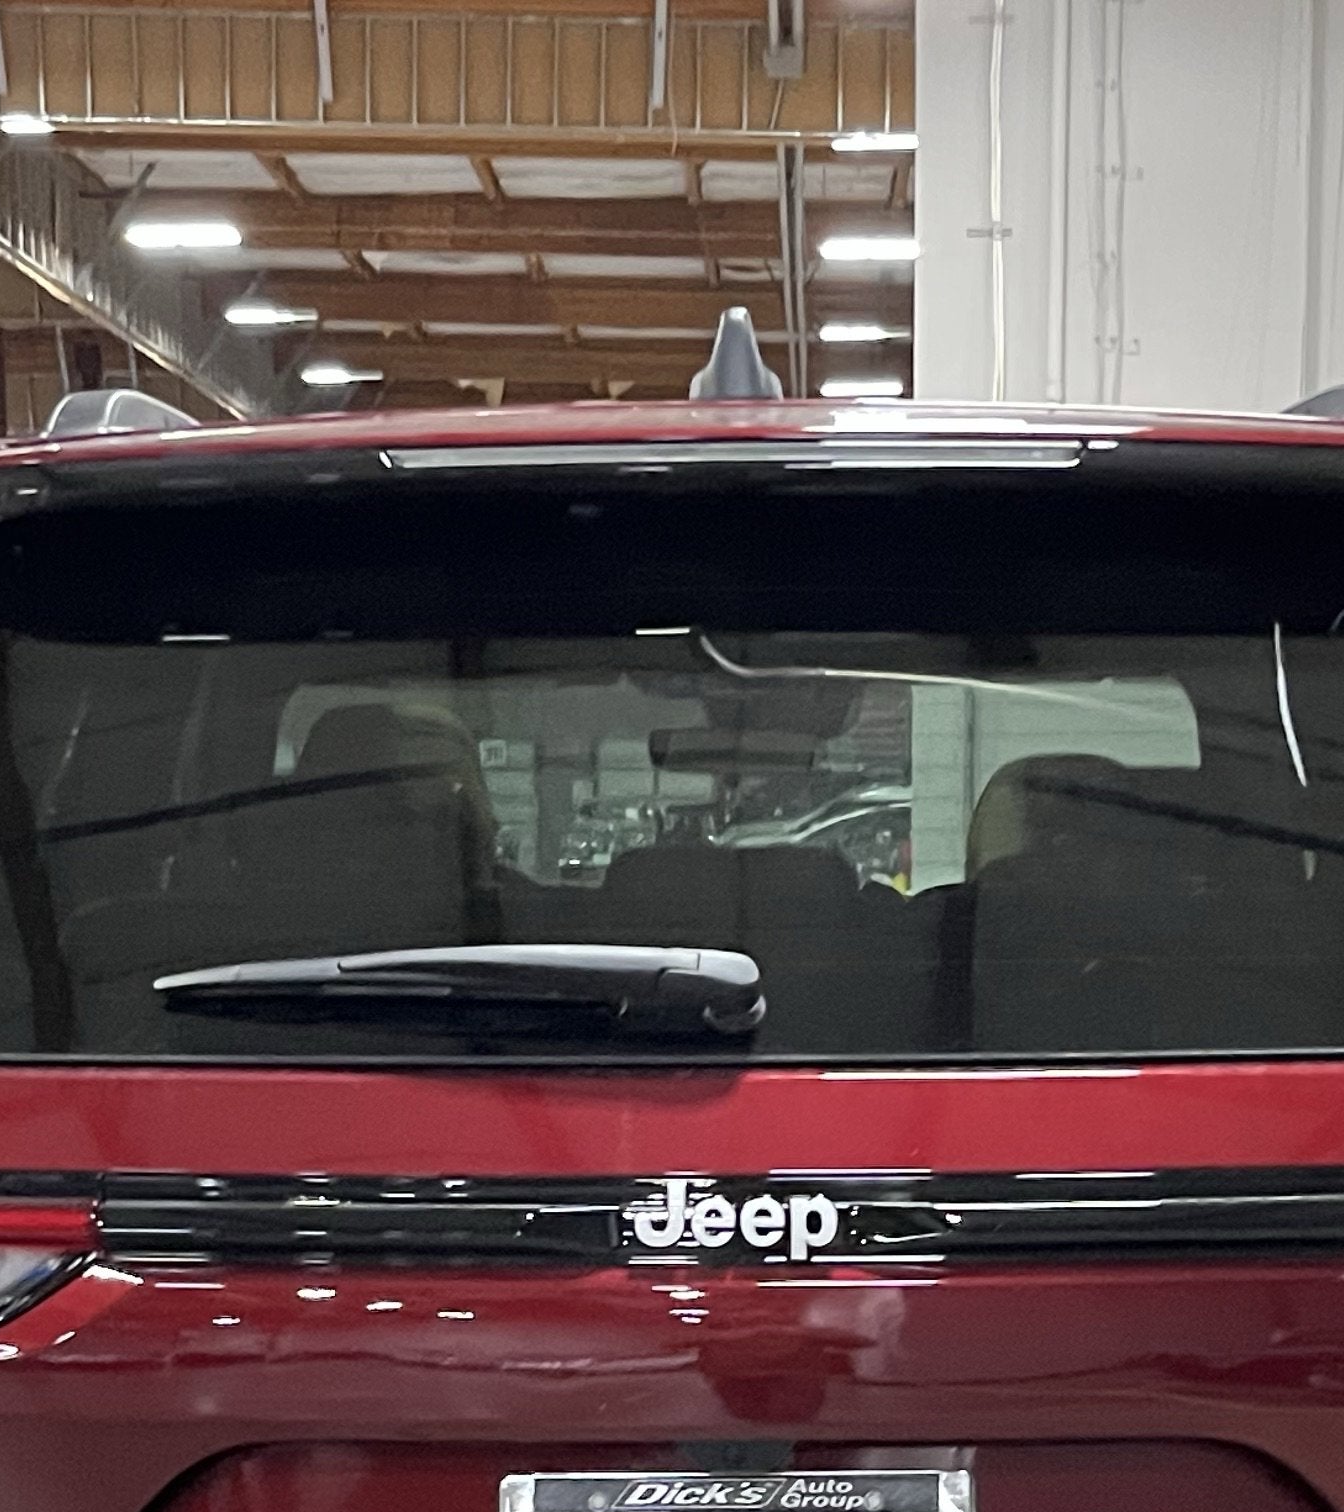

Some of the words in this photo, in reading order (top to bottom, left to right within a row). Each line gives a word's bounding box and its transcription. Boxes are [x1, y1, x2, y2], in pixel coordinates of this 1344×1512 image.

[633, 1179, 839, 1261] Jeep
[624, 1481, 768, 1506] Dick's
[787, 1478, 854, 1495] Auto
[780, 1493, 866, 1511] Group
